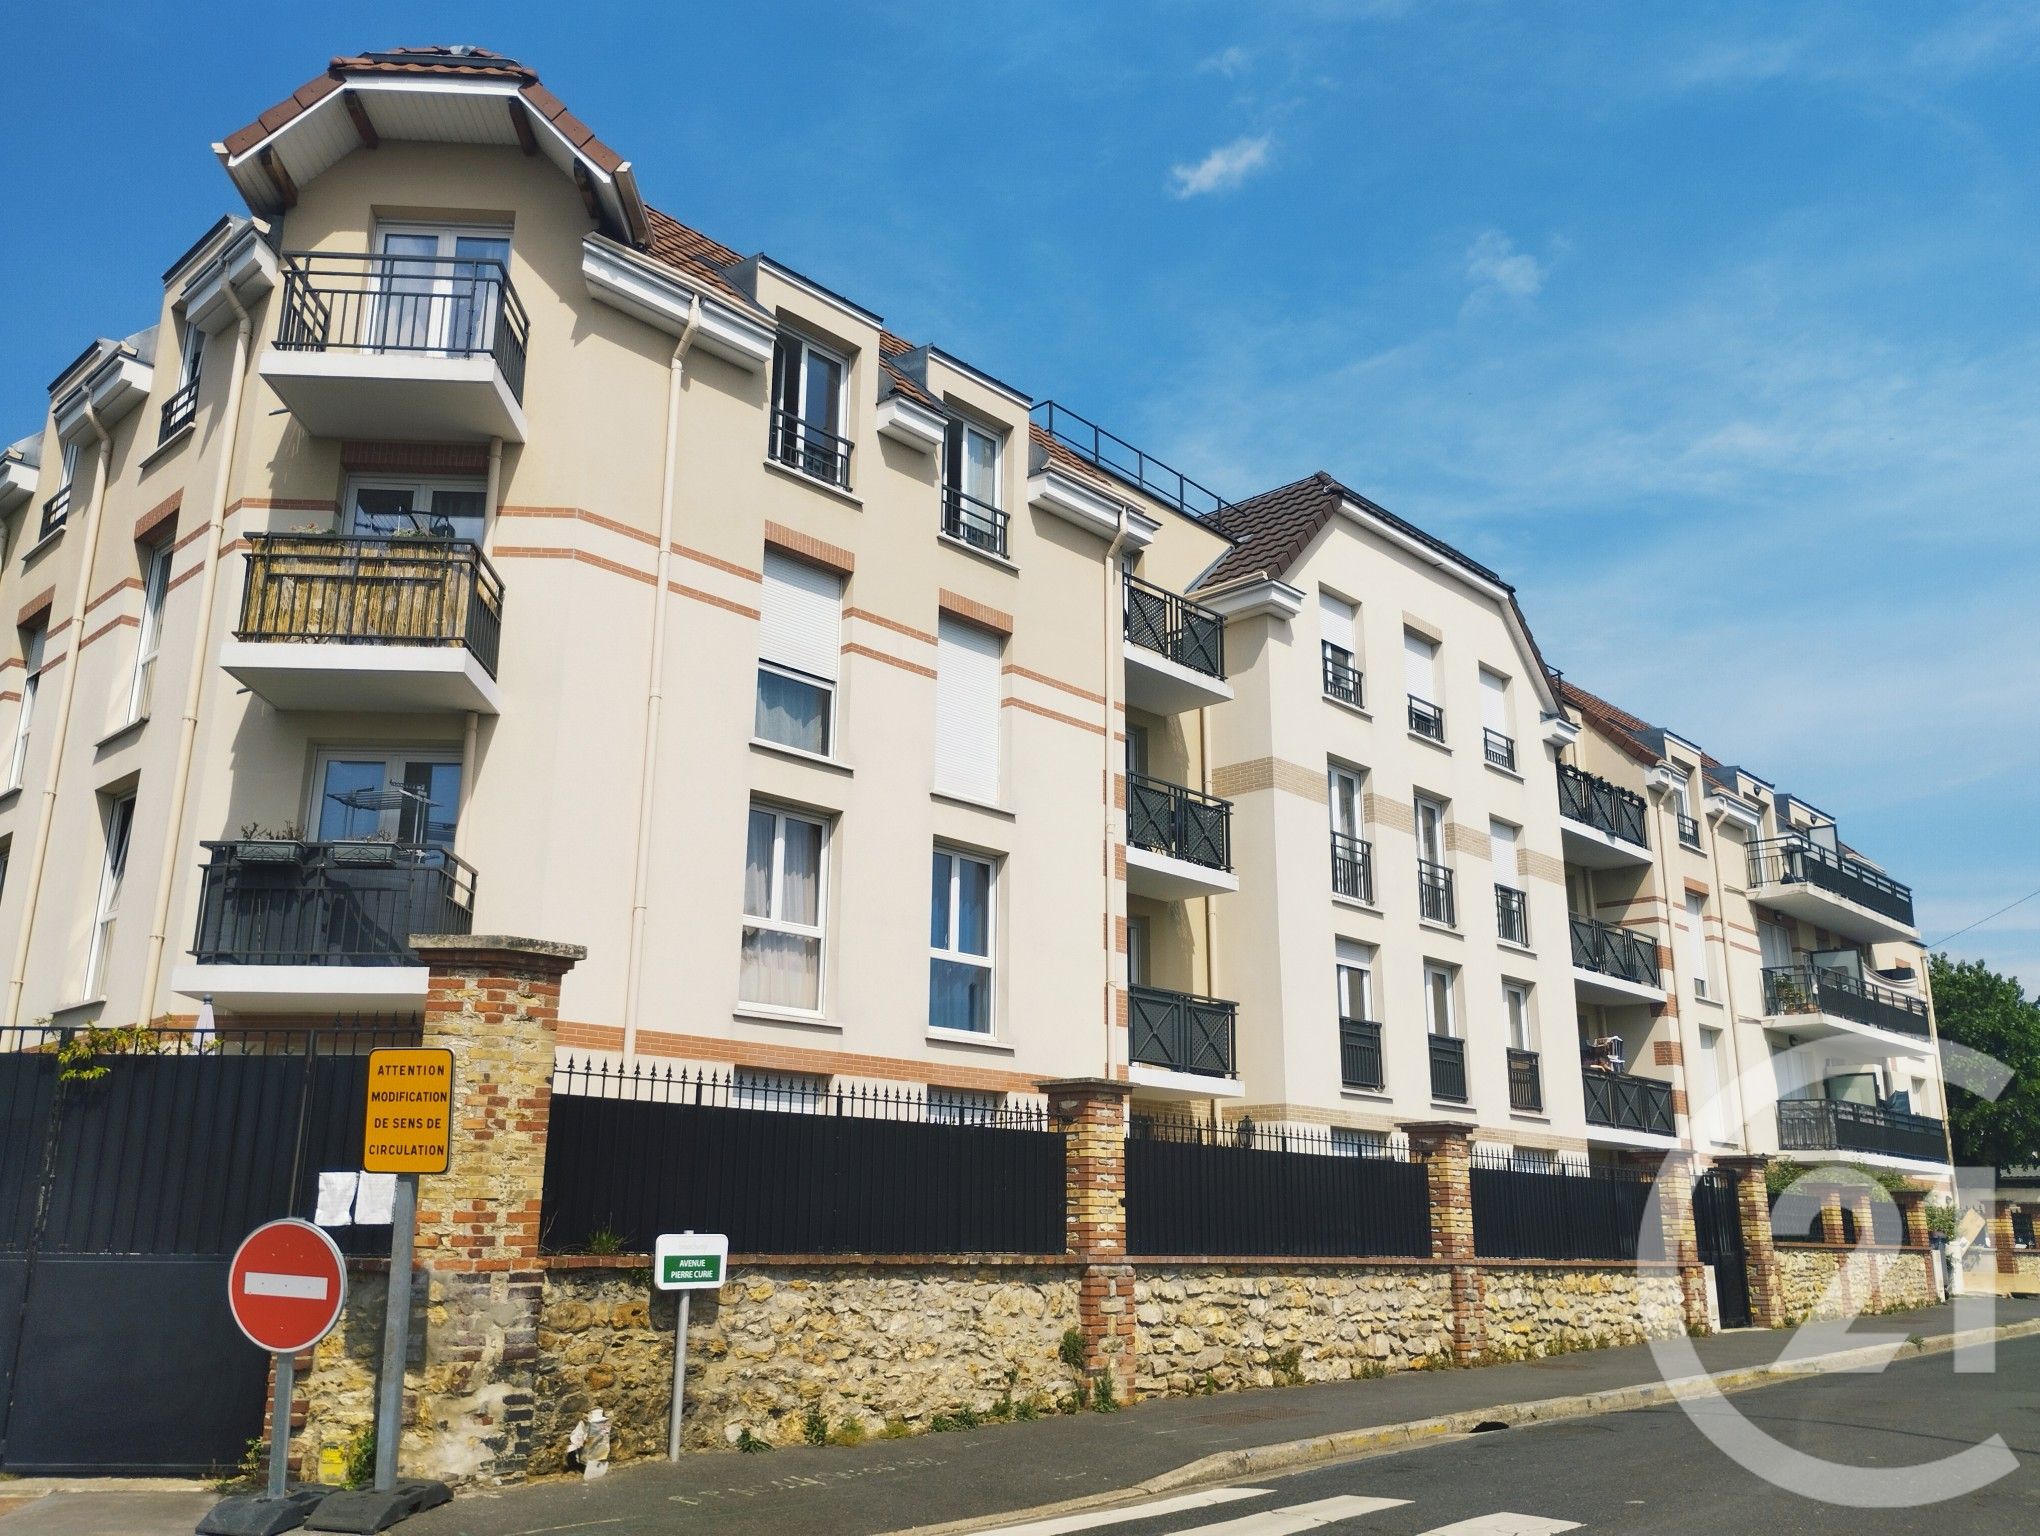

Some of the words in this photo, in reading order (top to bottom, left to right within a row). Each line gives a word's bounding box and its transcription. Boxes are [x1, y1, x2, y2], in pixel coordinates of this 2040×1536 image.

[377, 1065, 445, 1076] ATTENTION
[371, 1091, 447, 1103] MODIFICATION
[374, 1118, 389, 1129] DE
[392, 1118, 424, 1129] SENS
[426, 1118, 442, 1129] DE
[368, 1144, 445, 1156] CIRCULATION
[679, 1259, 706, 1268] AVENUE
[670, 1270, 693, 1279] PIERRE
[693, 1270, 714, 1278] CURIE
